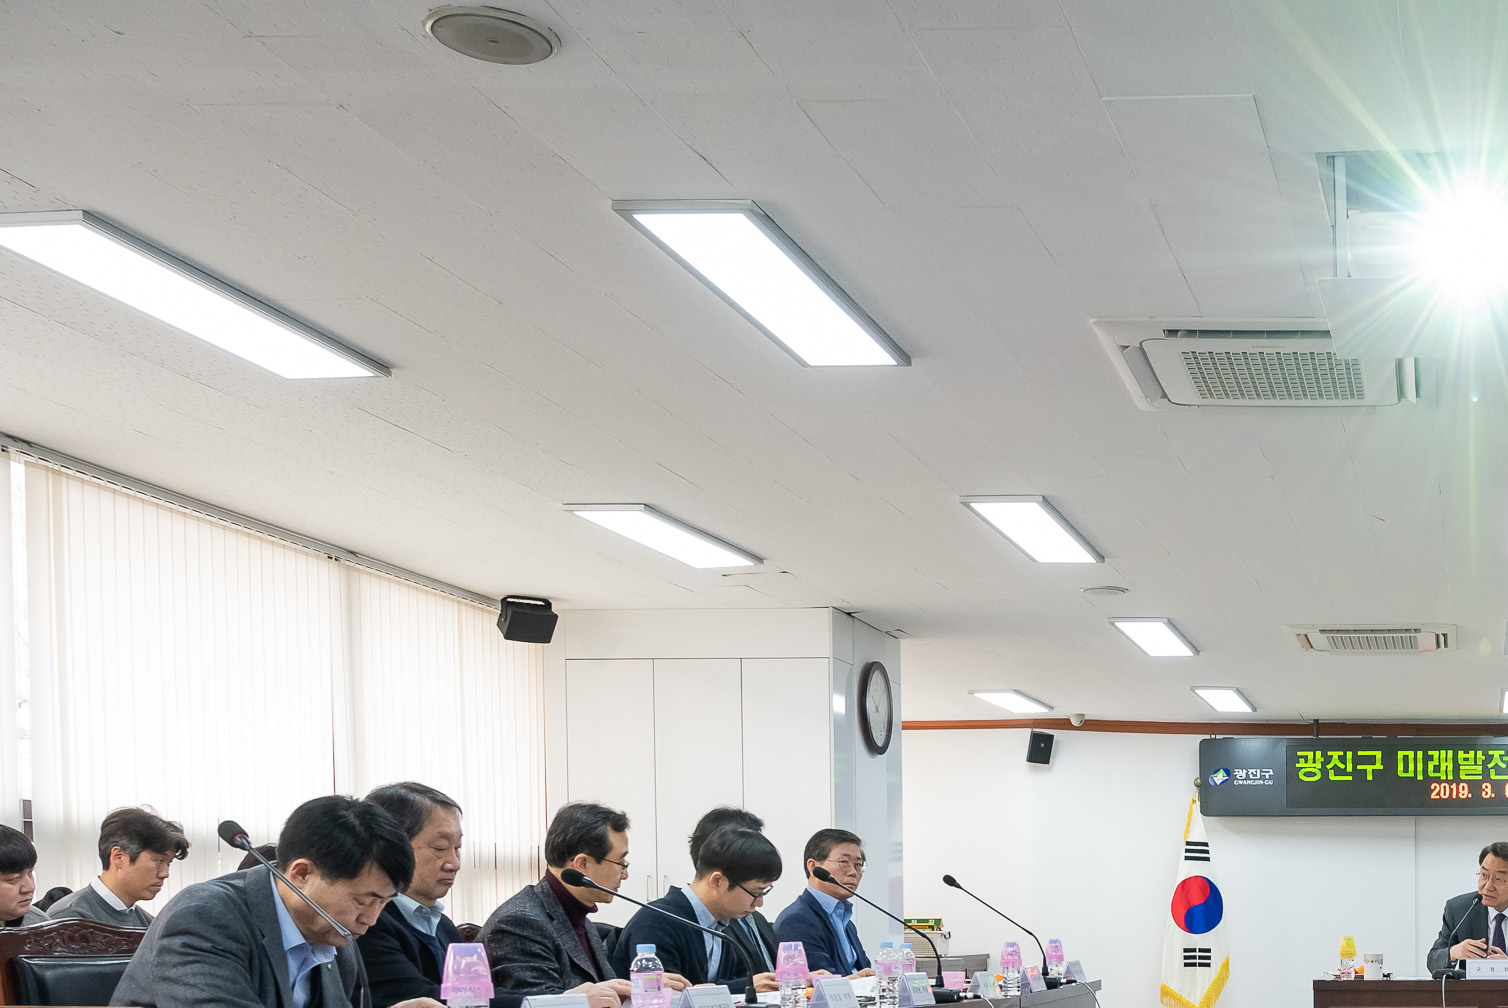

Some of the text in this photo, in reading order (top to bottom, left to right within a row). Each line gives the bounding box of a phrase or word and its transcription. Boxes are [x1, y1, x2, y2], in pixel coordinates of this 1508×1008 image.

[1233, 768, 1274, 780] 광진구
[1295, 749, 1384, 782] 광진구
[1430, 782, 1473, 799] 2019.
[1481, 782, 1496, 799] 3.
